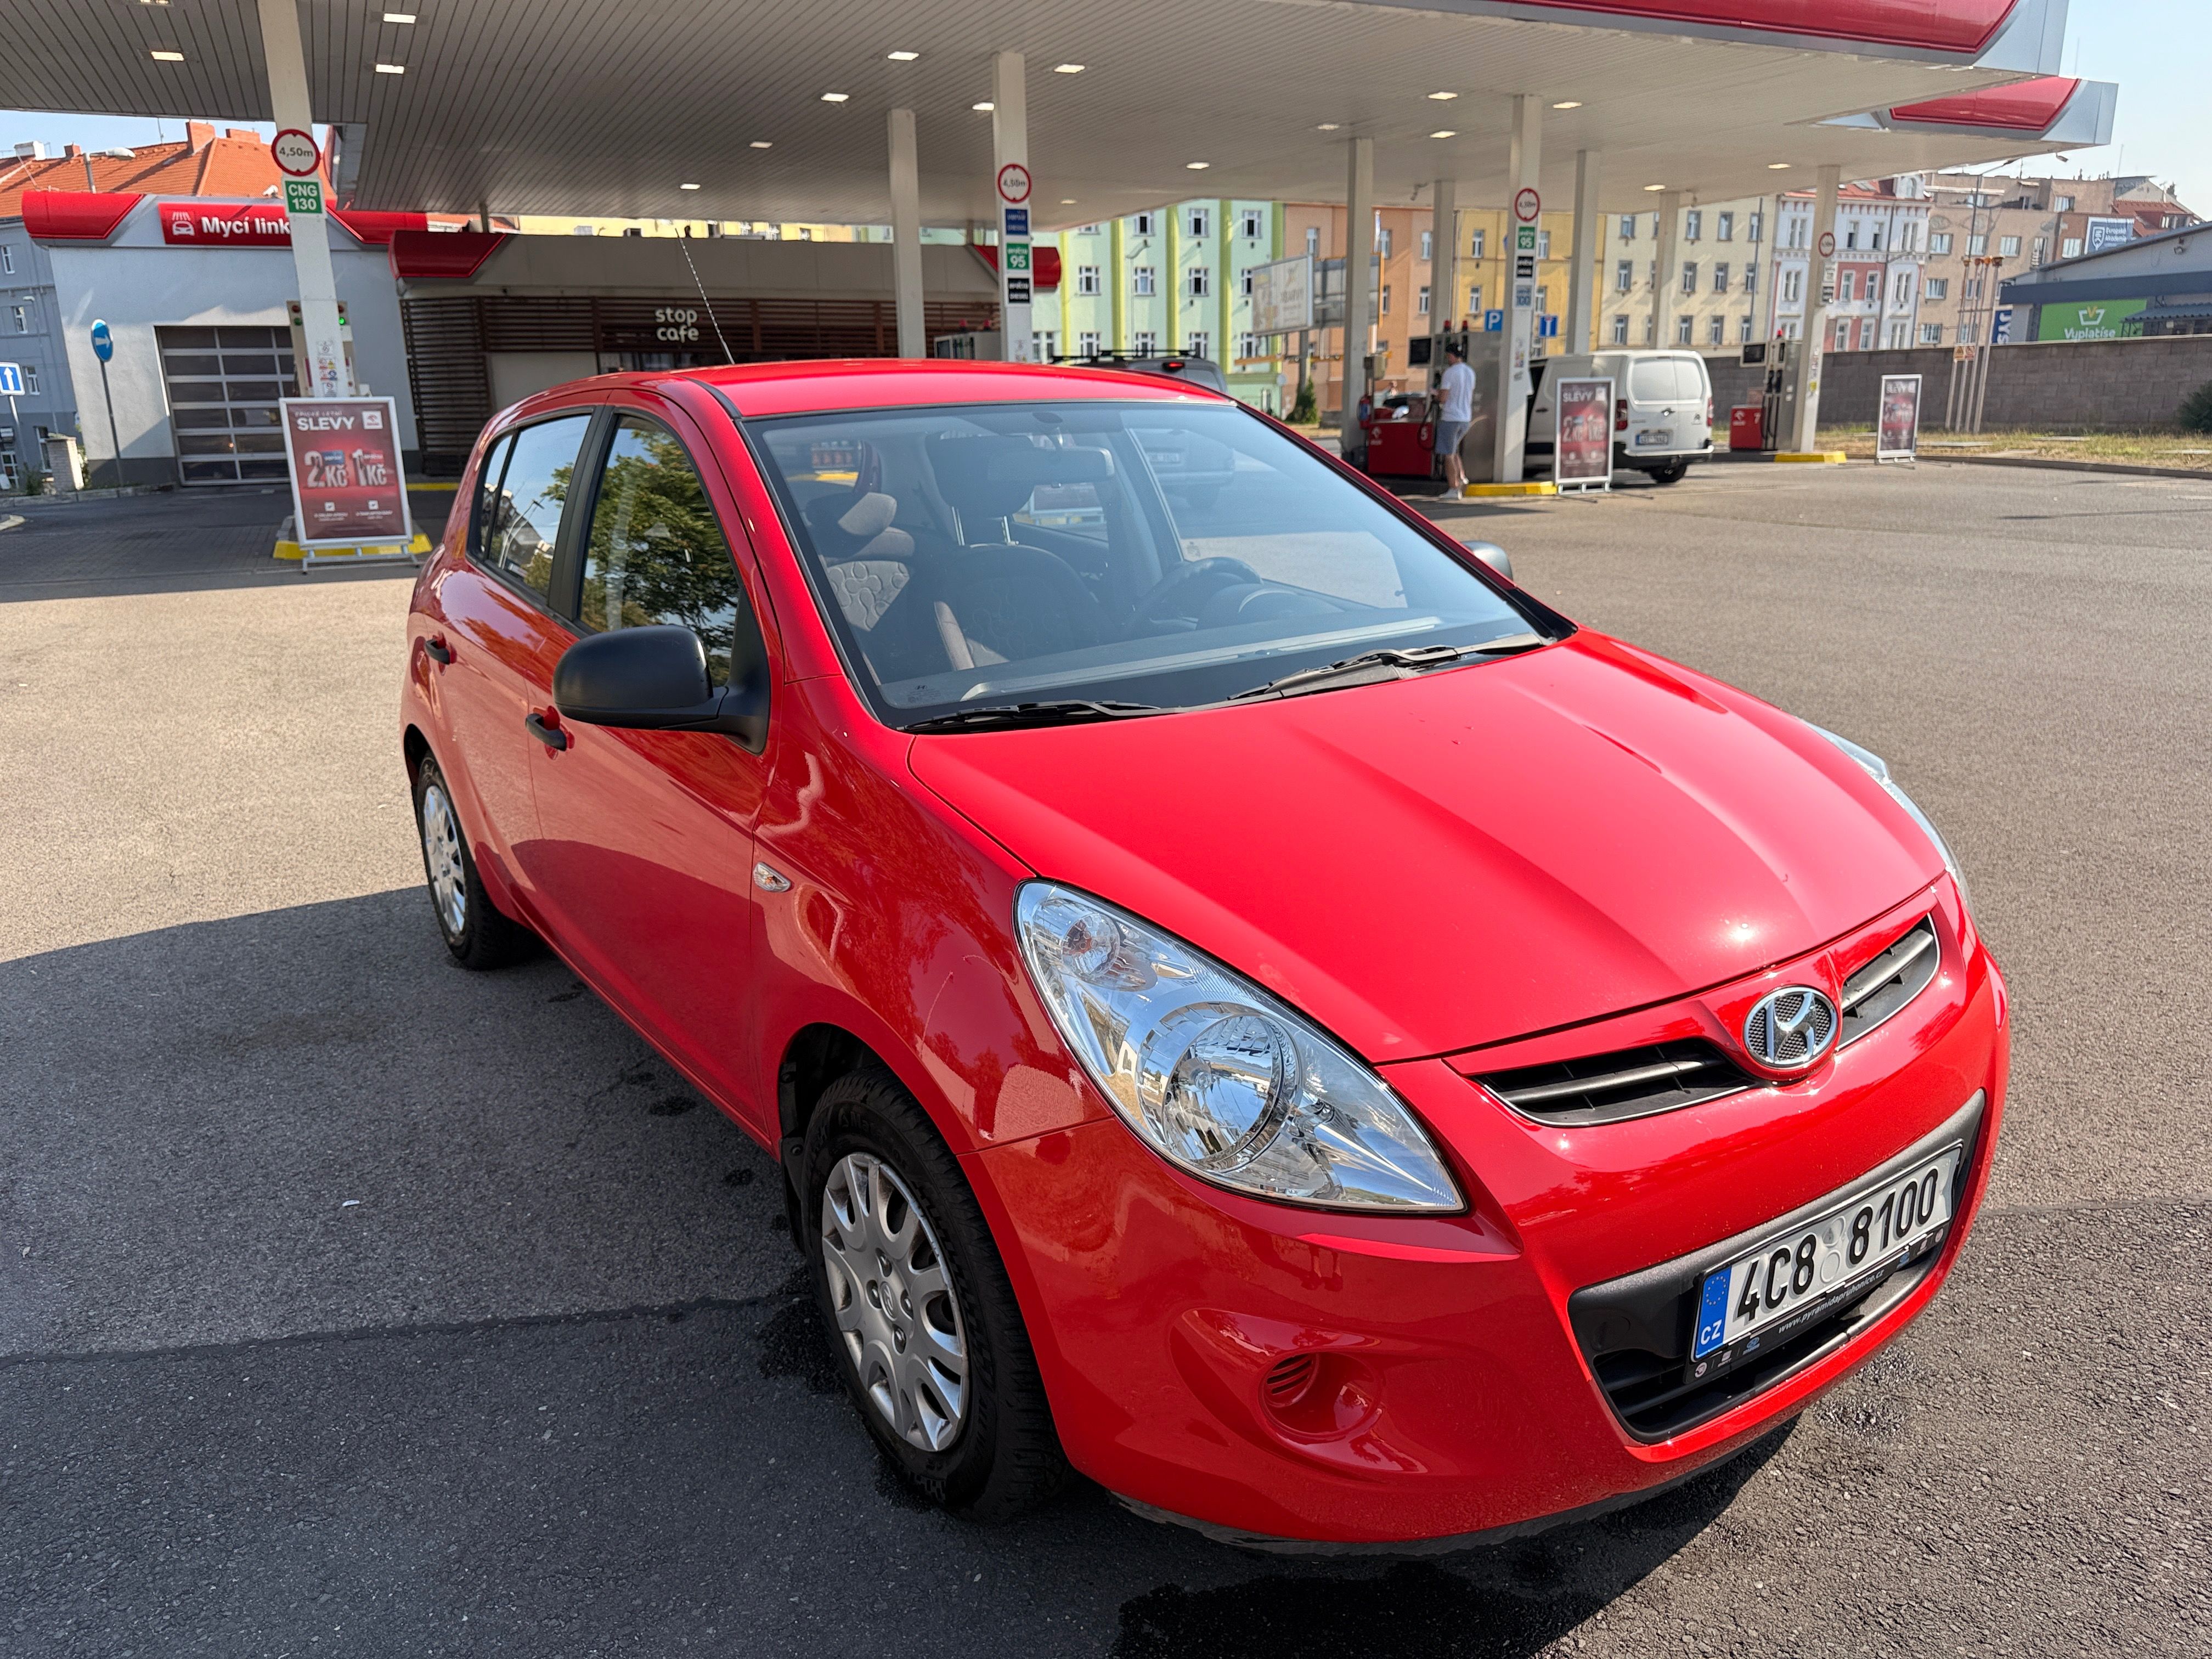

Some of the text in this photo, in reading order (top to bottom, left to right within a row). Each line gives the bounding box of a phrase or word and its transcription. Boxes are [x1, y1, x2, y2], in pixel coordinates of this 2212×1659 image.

[279, 146, 313, 157] 4,50m
[288, 184, 318, 197] CNG
[292, 198, 317, 210] 130
[201, 216, 291, 238] Mycí link
[1520, 238, 1533, 248] 95
[1011, 255, 1026, 268] 95
[654, 307, 698, 326] stop
[1488, 312, 1501, 330] P
[656, 325, 699, 343] cafe
[1997, 312, 2012, 345] JYS
[1563, 391, 1593, 402] SLEVY
[297, 416, 354, 431] SLEVY
[1421, 426, 1428, 441] 5
[304, 450, 325, 488] 2
[352, 448, 368, 487] 1
[1737, 1168, 1938, 1321] 4C8 8100
[1778, 1269, 1884, 1334] www.pyramidapruhonice.cz
[1701, 1319, 1722, 1345] CZ
